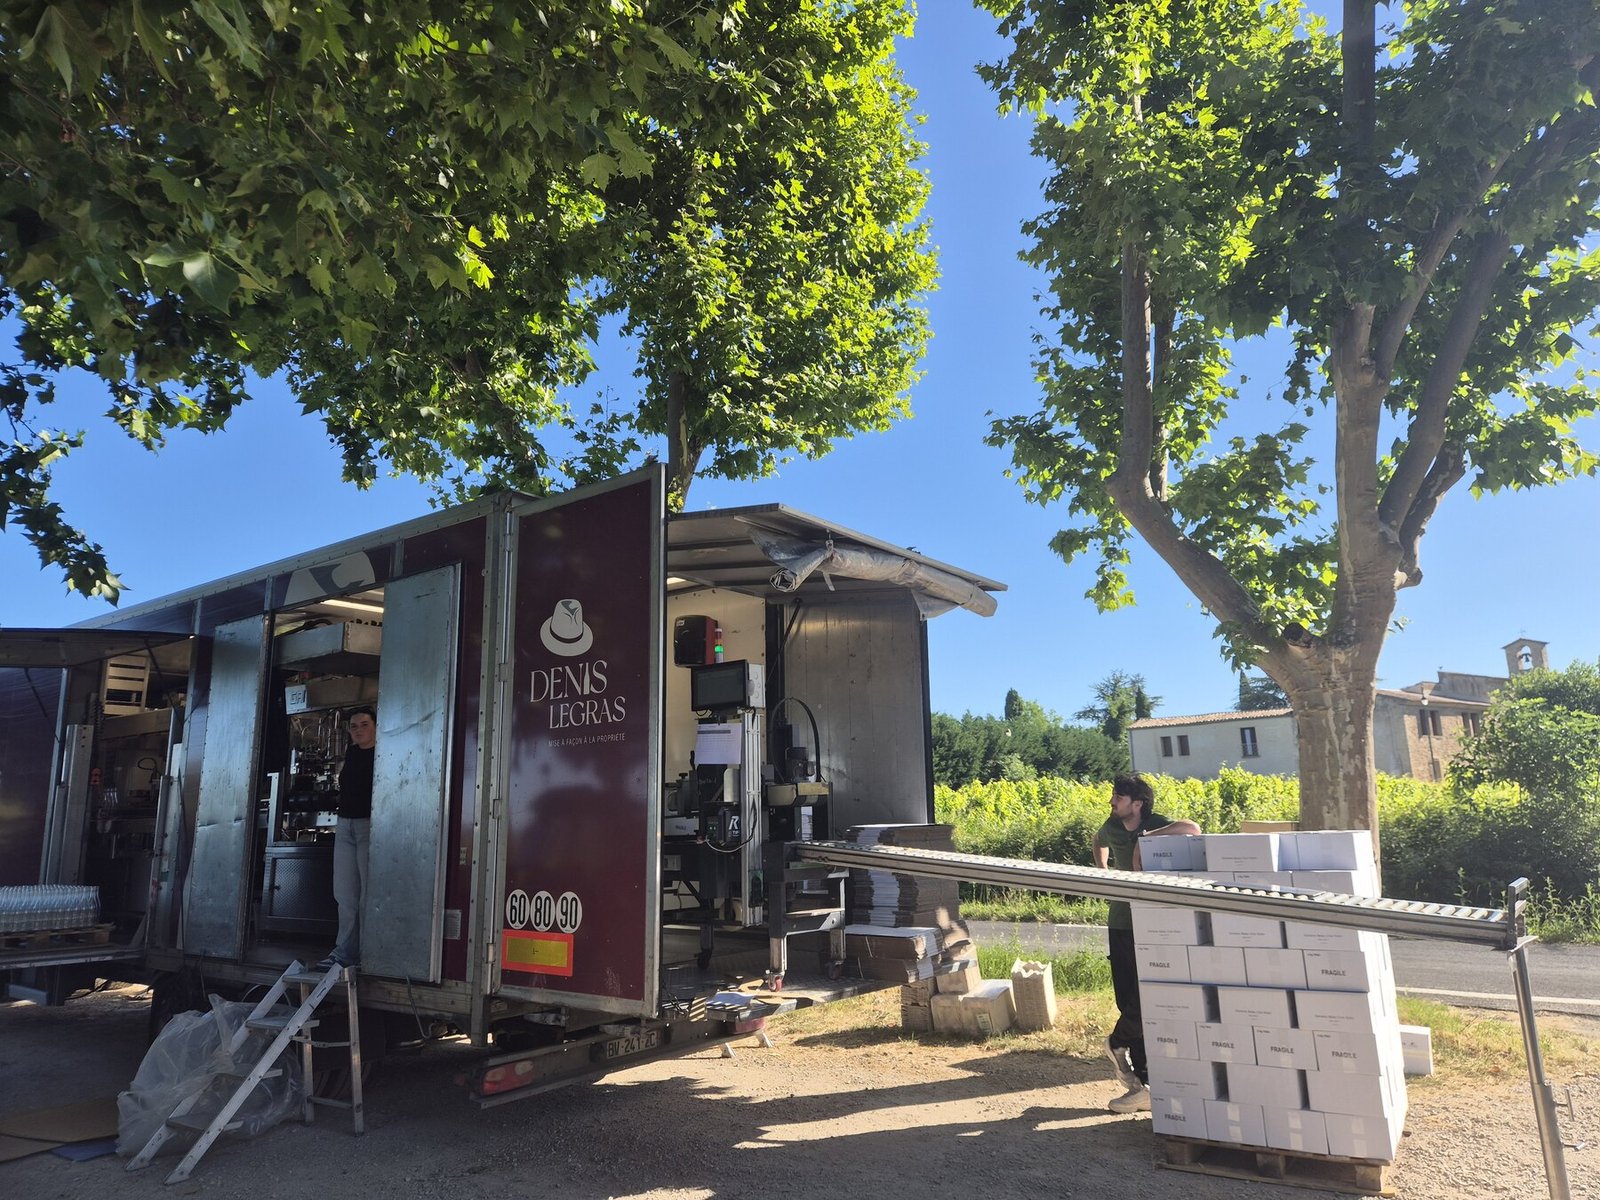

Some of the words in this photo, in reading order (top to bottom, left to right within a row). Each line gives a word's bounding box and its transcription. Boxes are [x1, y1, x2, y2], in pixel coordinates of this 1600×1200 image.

[530, 660, 607, 702] DENIS
[550, 696, 626, 729] LEGRAS
[588, 735, 596, 744] LA
[510, 894, 526, 925] 60
[534, 896, 552, 928] 80
[560, 896, 578, 929] 90
[1212, 1041, 1234, 1049] FRAGILE
[1270, 1046, 1294, 1054] FRAGILE
[1332, 1050, 1357, 1059] FRAGILE
[1164, 1113, 1186, 1122] FRAGILE
